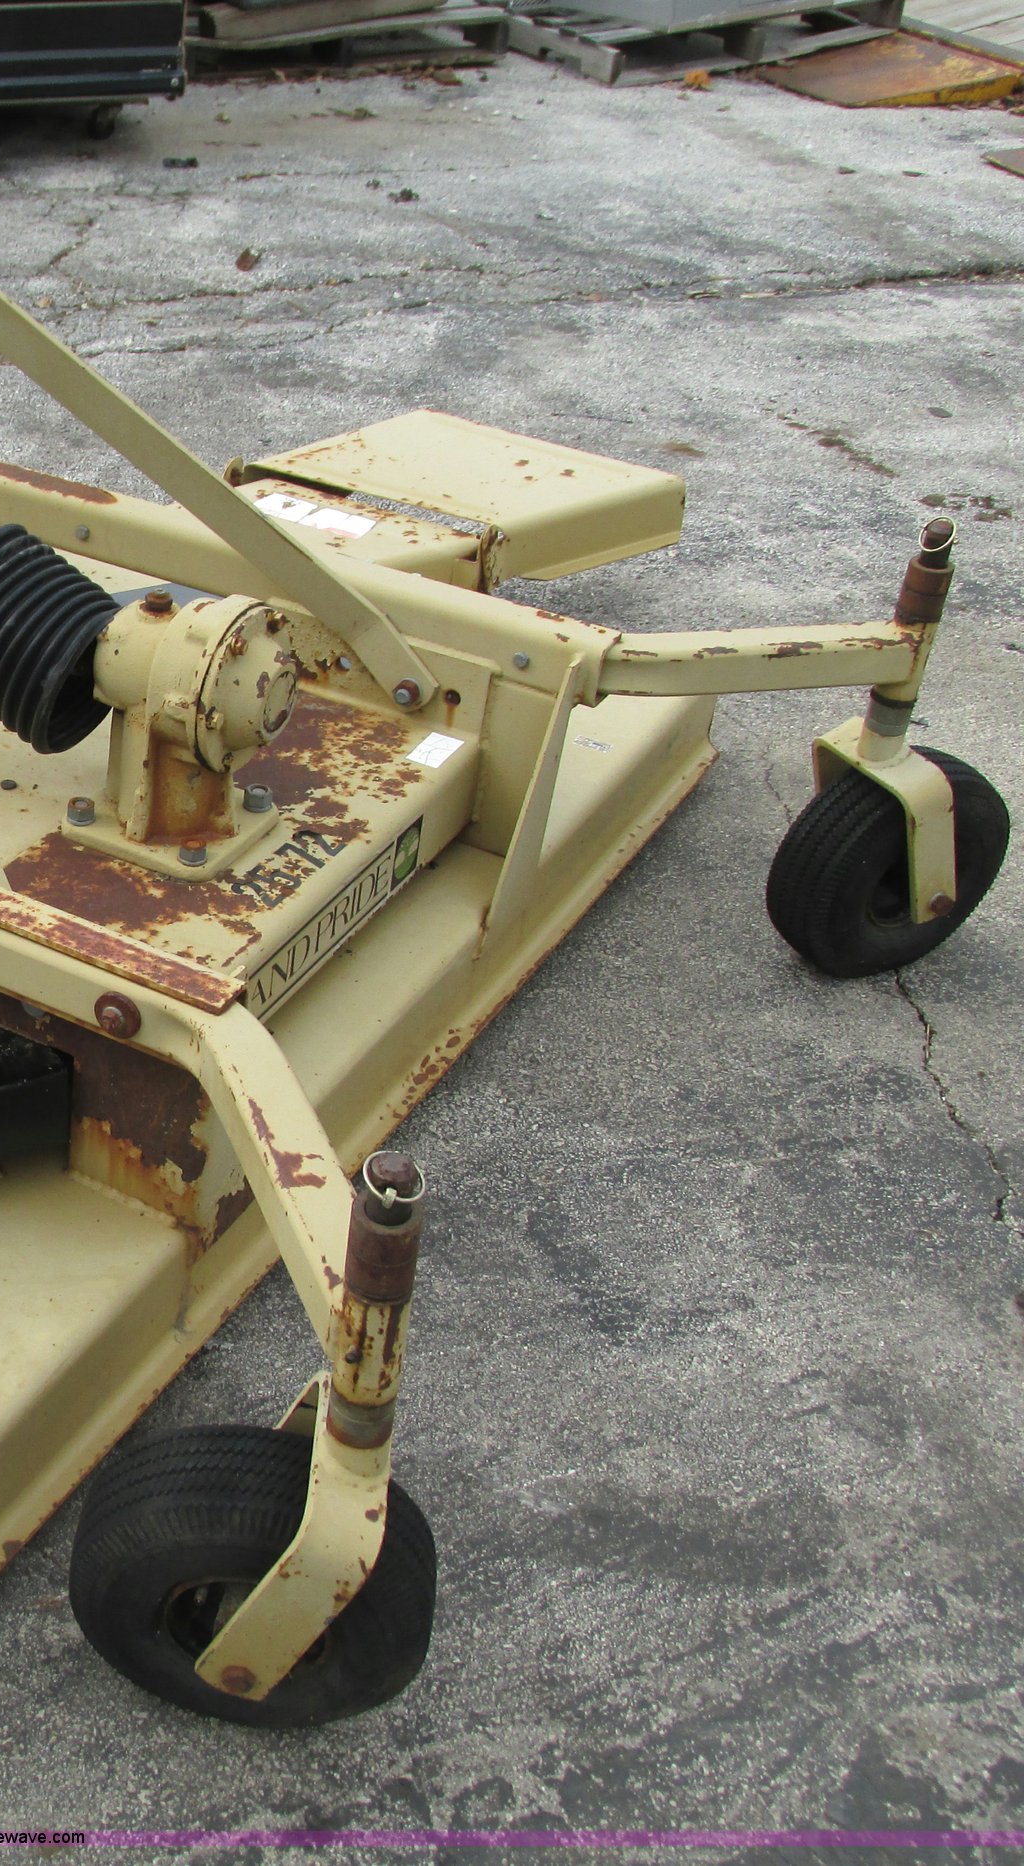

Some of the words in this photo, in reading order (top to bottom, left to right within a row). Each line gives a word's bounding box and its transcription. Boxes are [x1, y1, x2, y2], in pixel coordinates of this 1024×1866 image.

[231, 830, 347, 908] 2572
[251, 935, 310, 1005] AND
[314, 855, 390, 954] PRIDE
